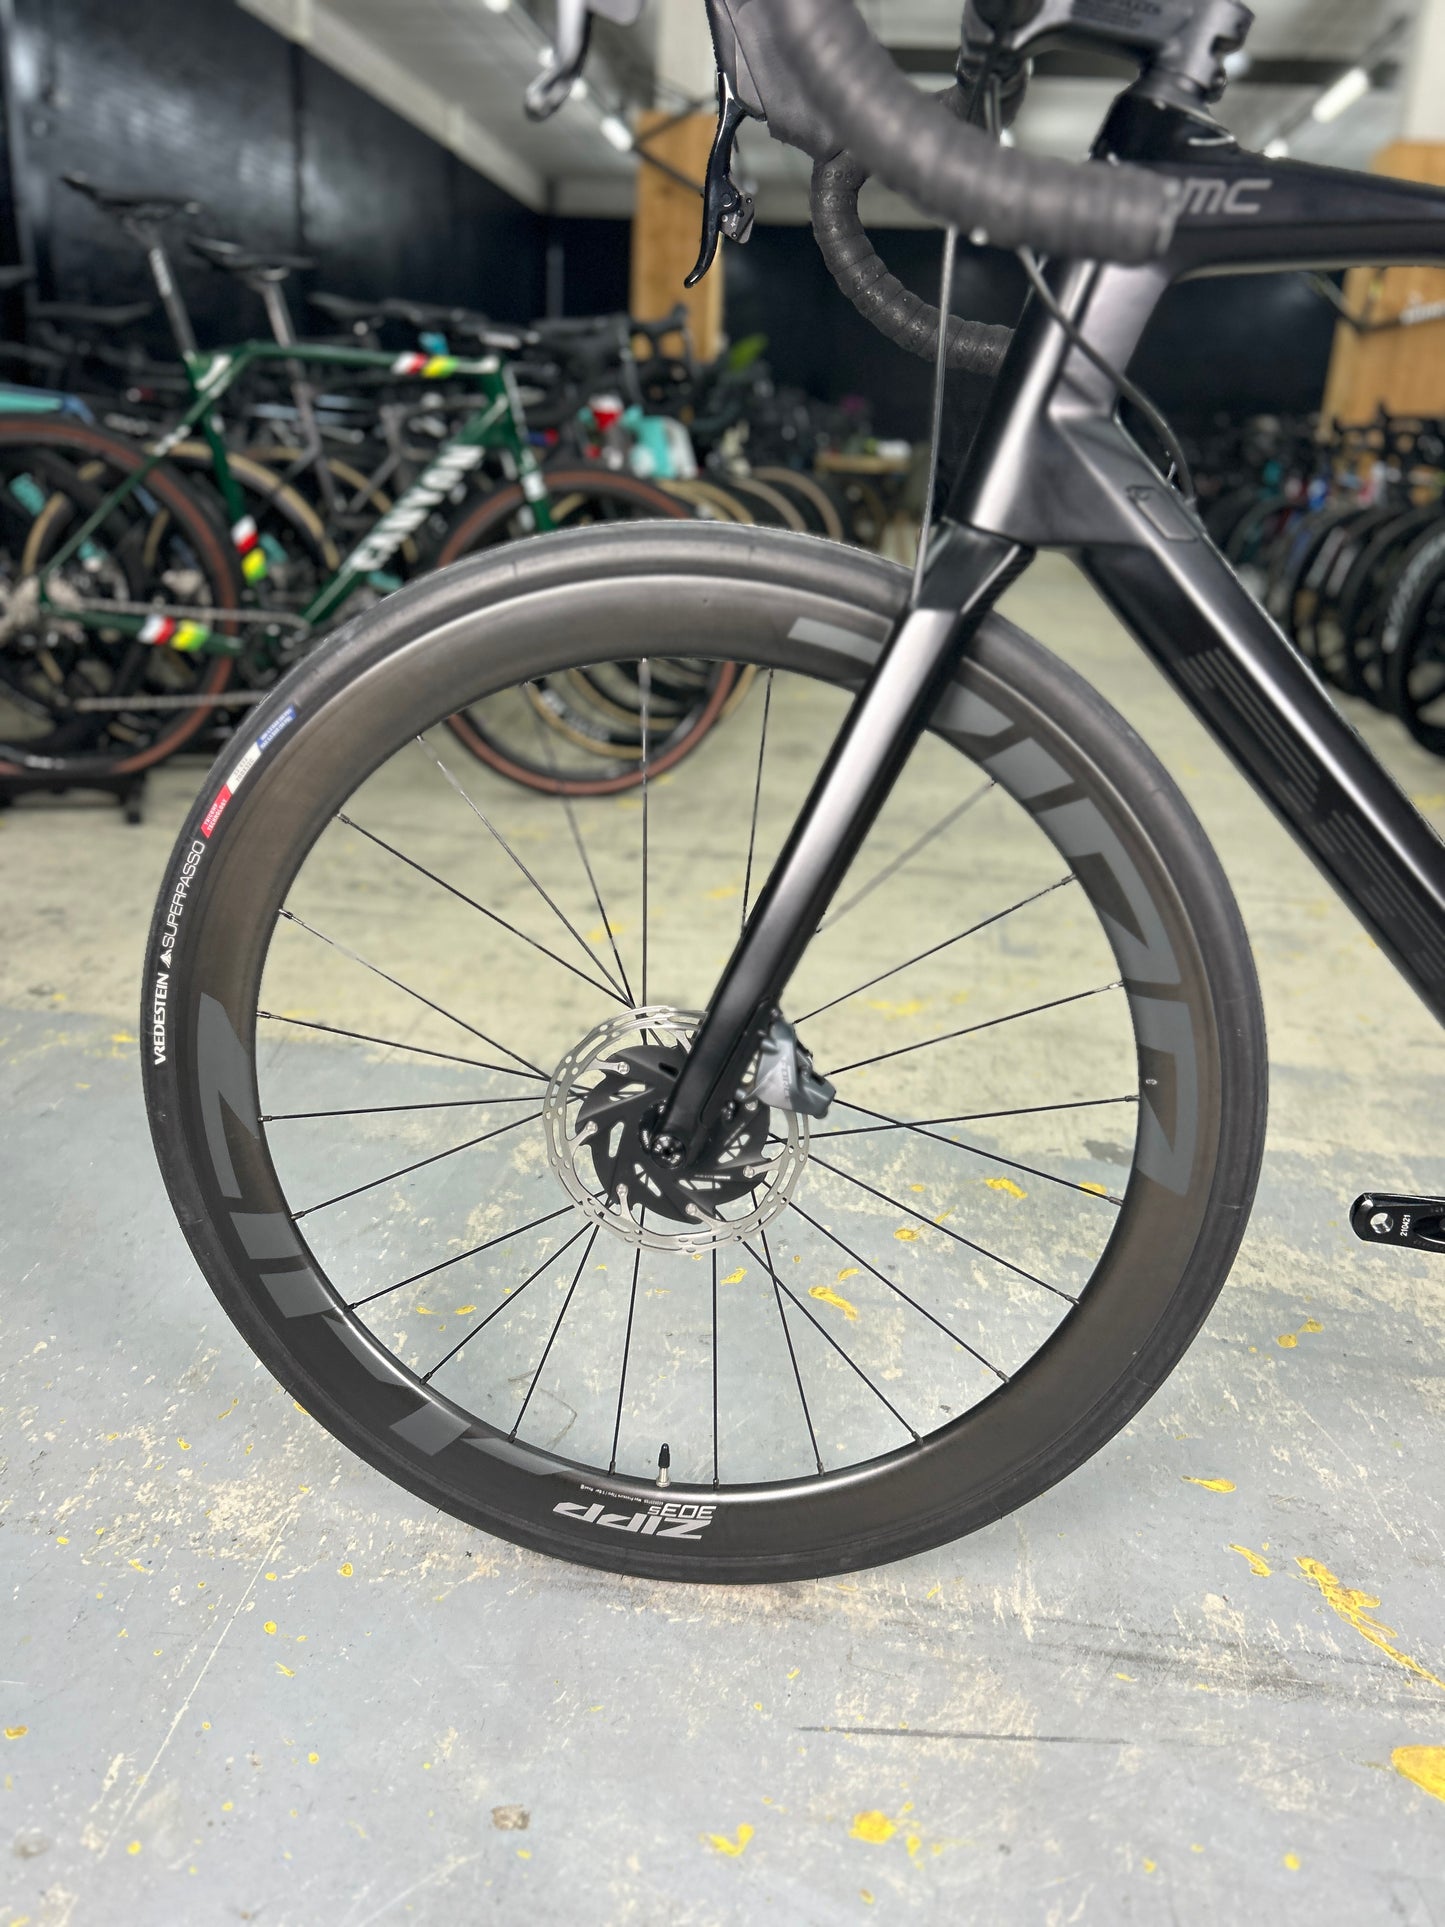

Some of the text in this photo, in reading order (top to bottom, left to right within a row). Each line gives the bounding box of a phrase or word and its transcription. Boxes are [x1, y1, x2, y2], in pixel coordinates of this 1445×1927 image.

[1176, 176, 1273, 215] MC
[206, 798, 228, 832] TECHNOLOGY
[162, 839, 205, 948] SUPERPASSO
[154, 972, 170, 1066] VREDESTEIN
[1399, 1214, 1411, 1237] 210421
[552, 1502, 712, 1540] ZIPP
